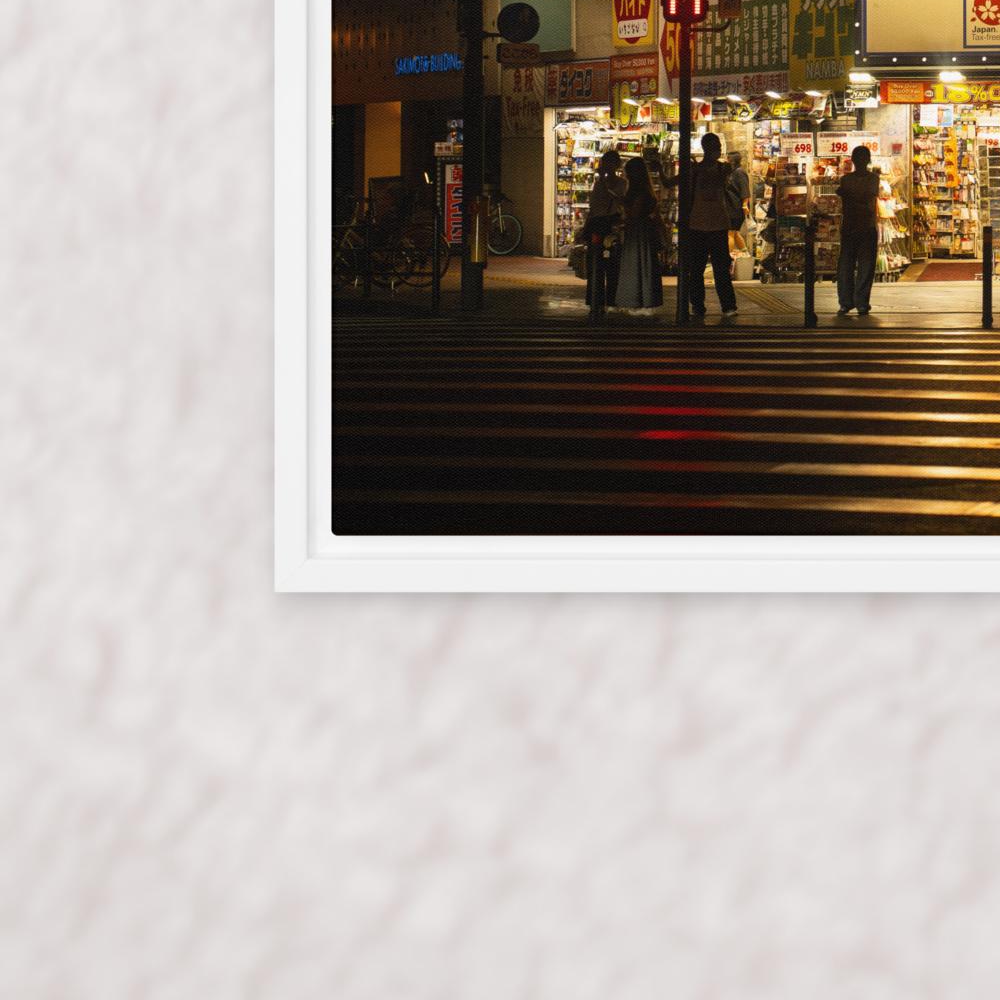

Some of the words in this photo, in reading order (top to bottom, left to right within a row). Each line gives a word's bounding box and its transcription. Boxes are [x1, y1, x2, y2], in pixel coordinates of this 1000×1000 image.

[805, 60, 845, 80] NAMBA
[794, 143, 812, 153] 698
[830, 142, 848, 153] 198
